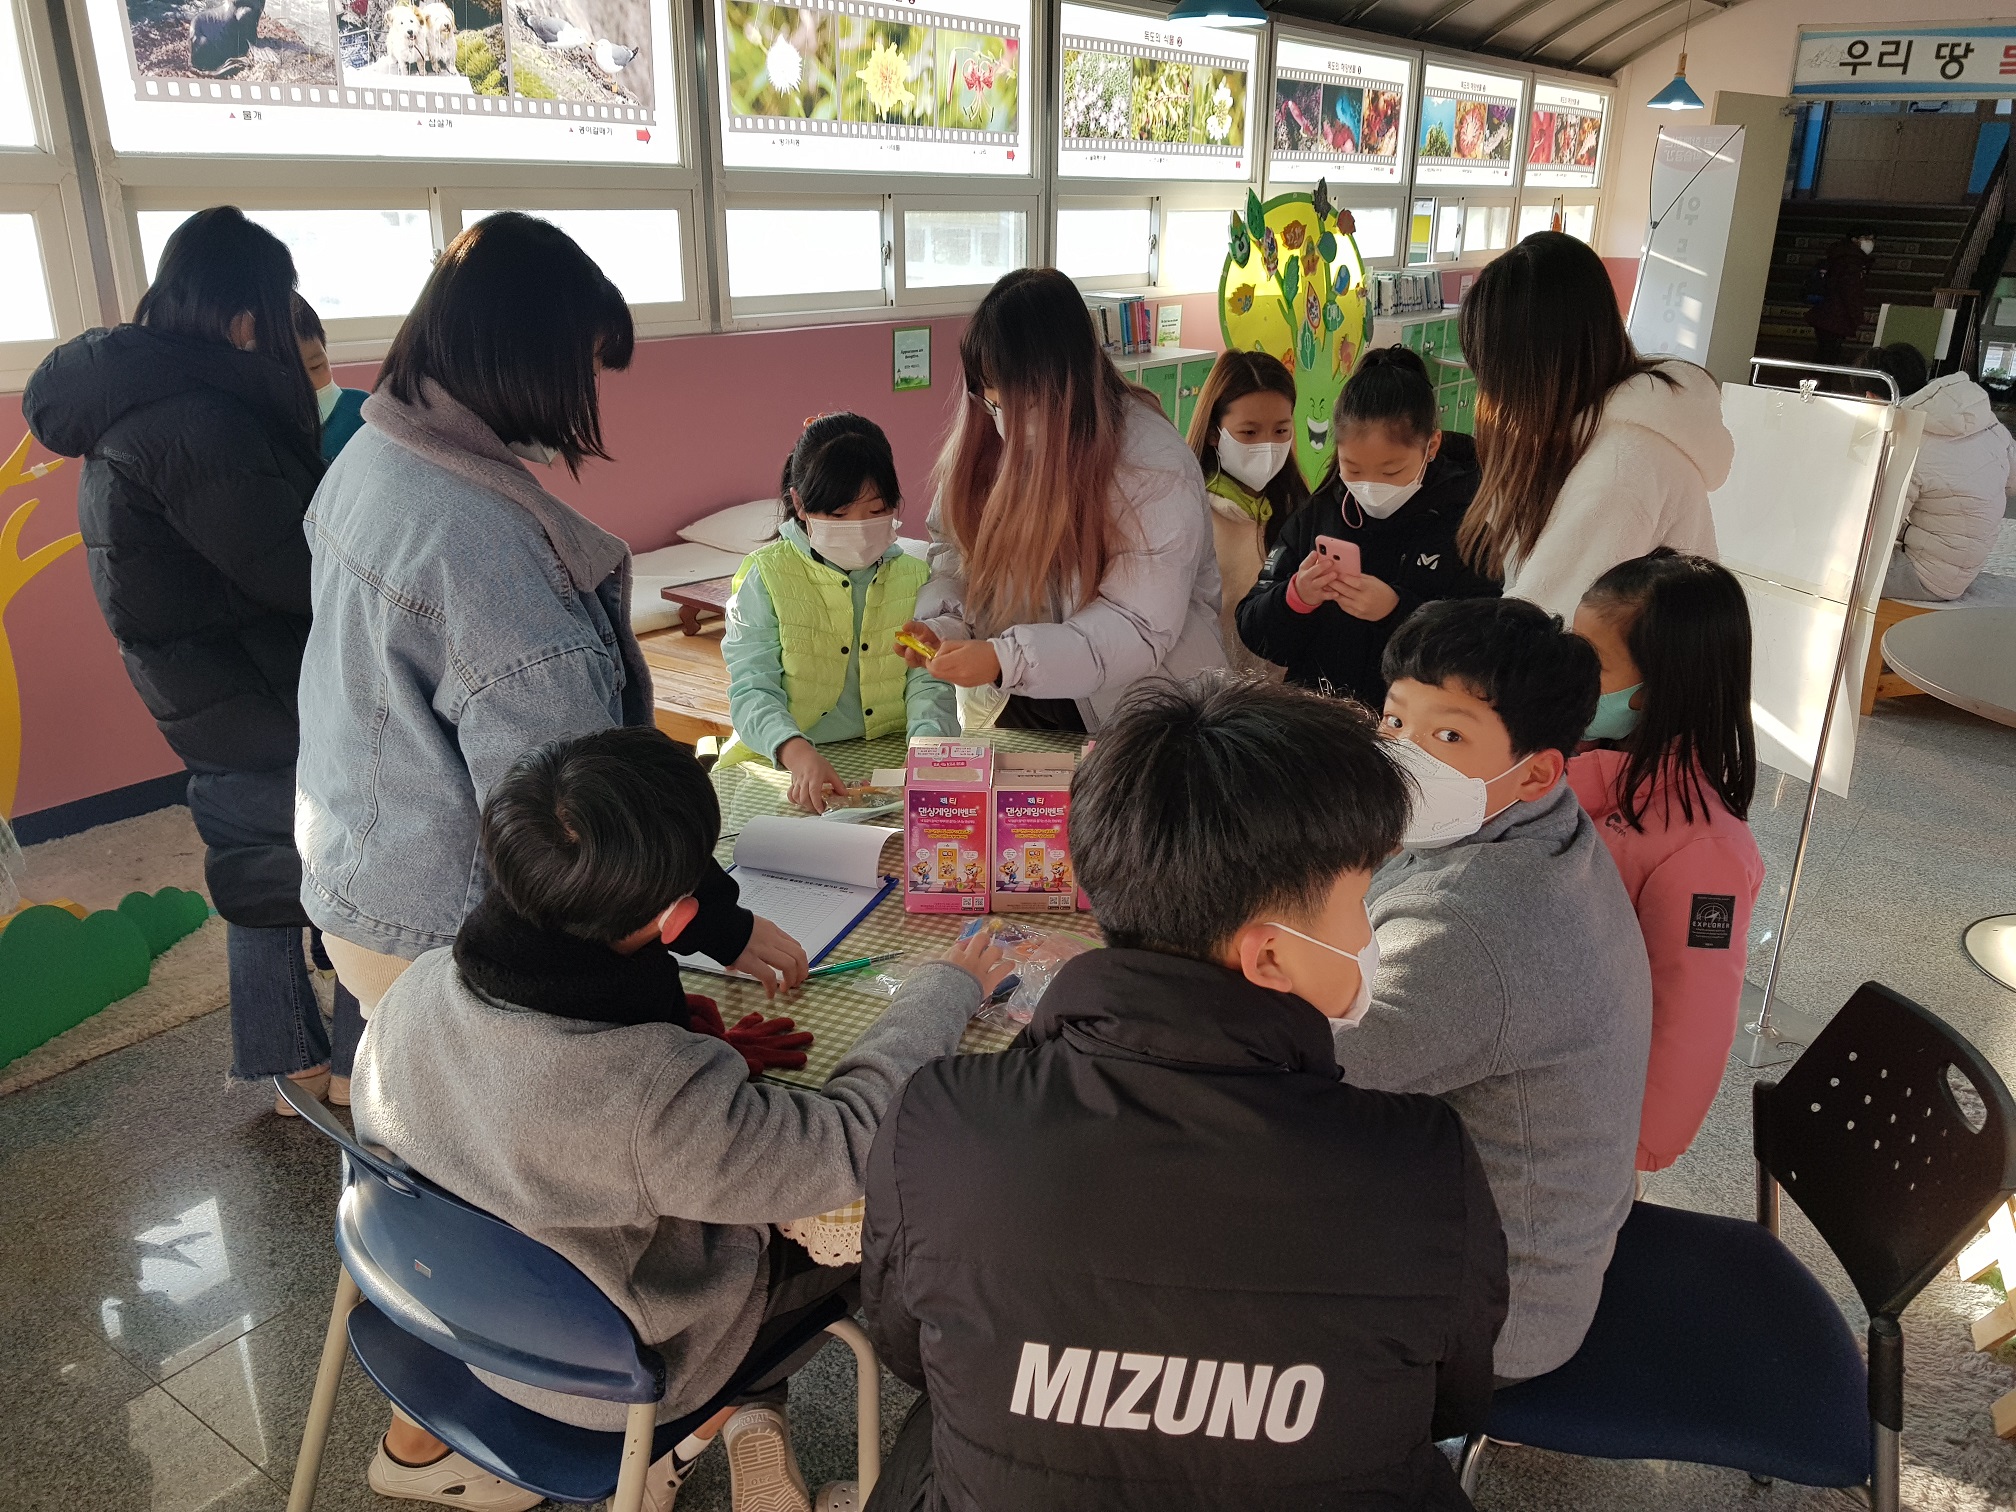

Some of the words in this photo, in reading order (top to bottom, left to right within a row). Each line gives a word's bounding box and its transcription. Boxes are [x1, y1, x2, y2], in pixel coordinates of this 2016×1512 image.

[1838, 39, 1914, 76] 우리
[1935, 42, 1975, 80] 땅
[1692, 920, 1730, 929] EXPLORER
[1009, 1341, 1325, 1444] MIZUNO
